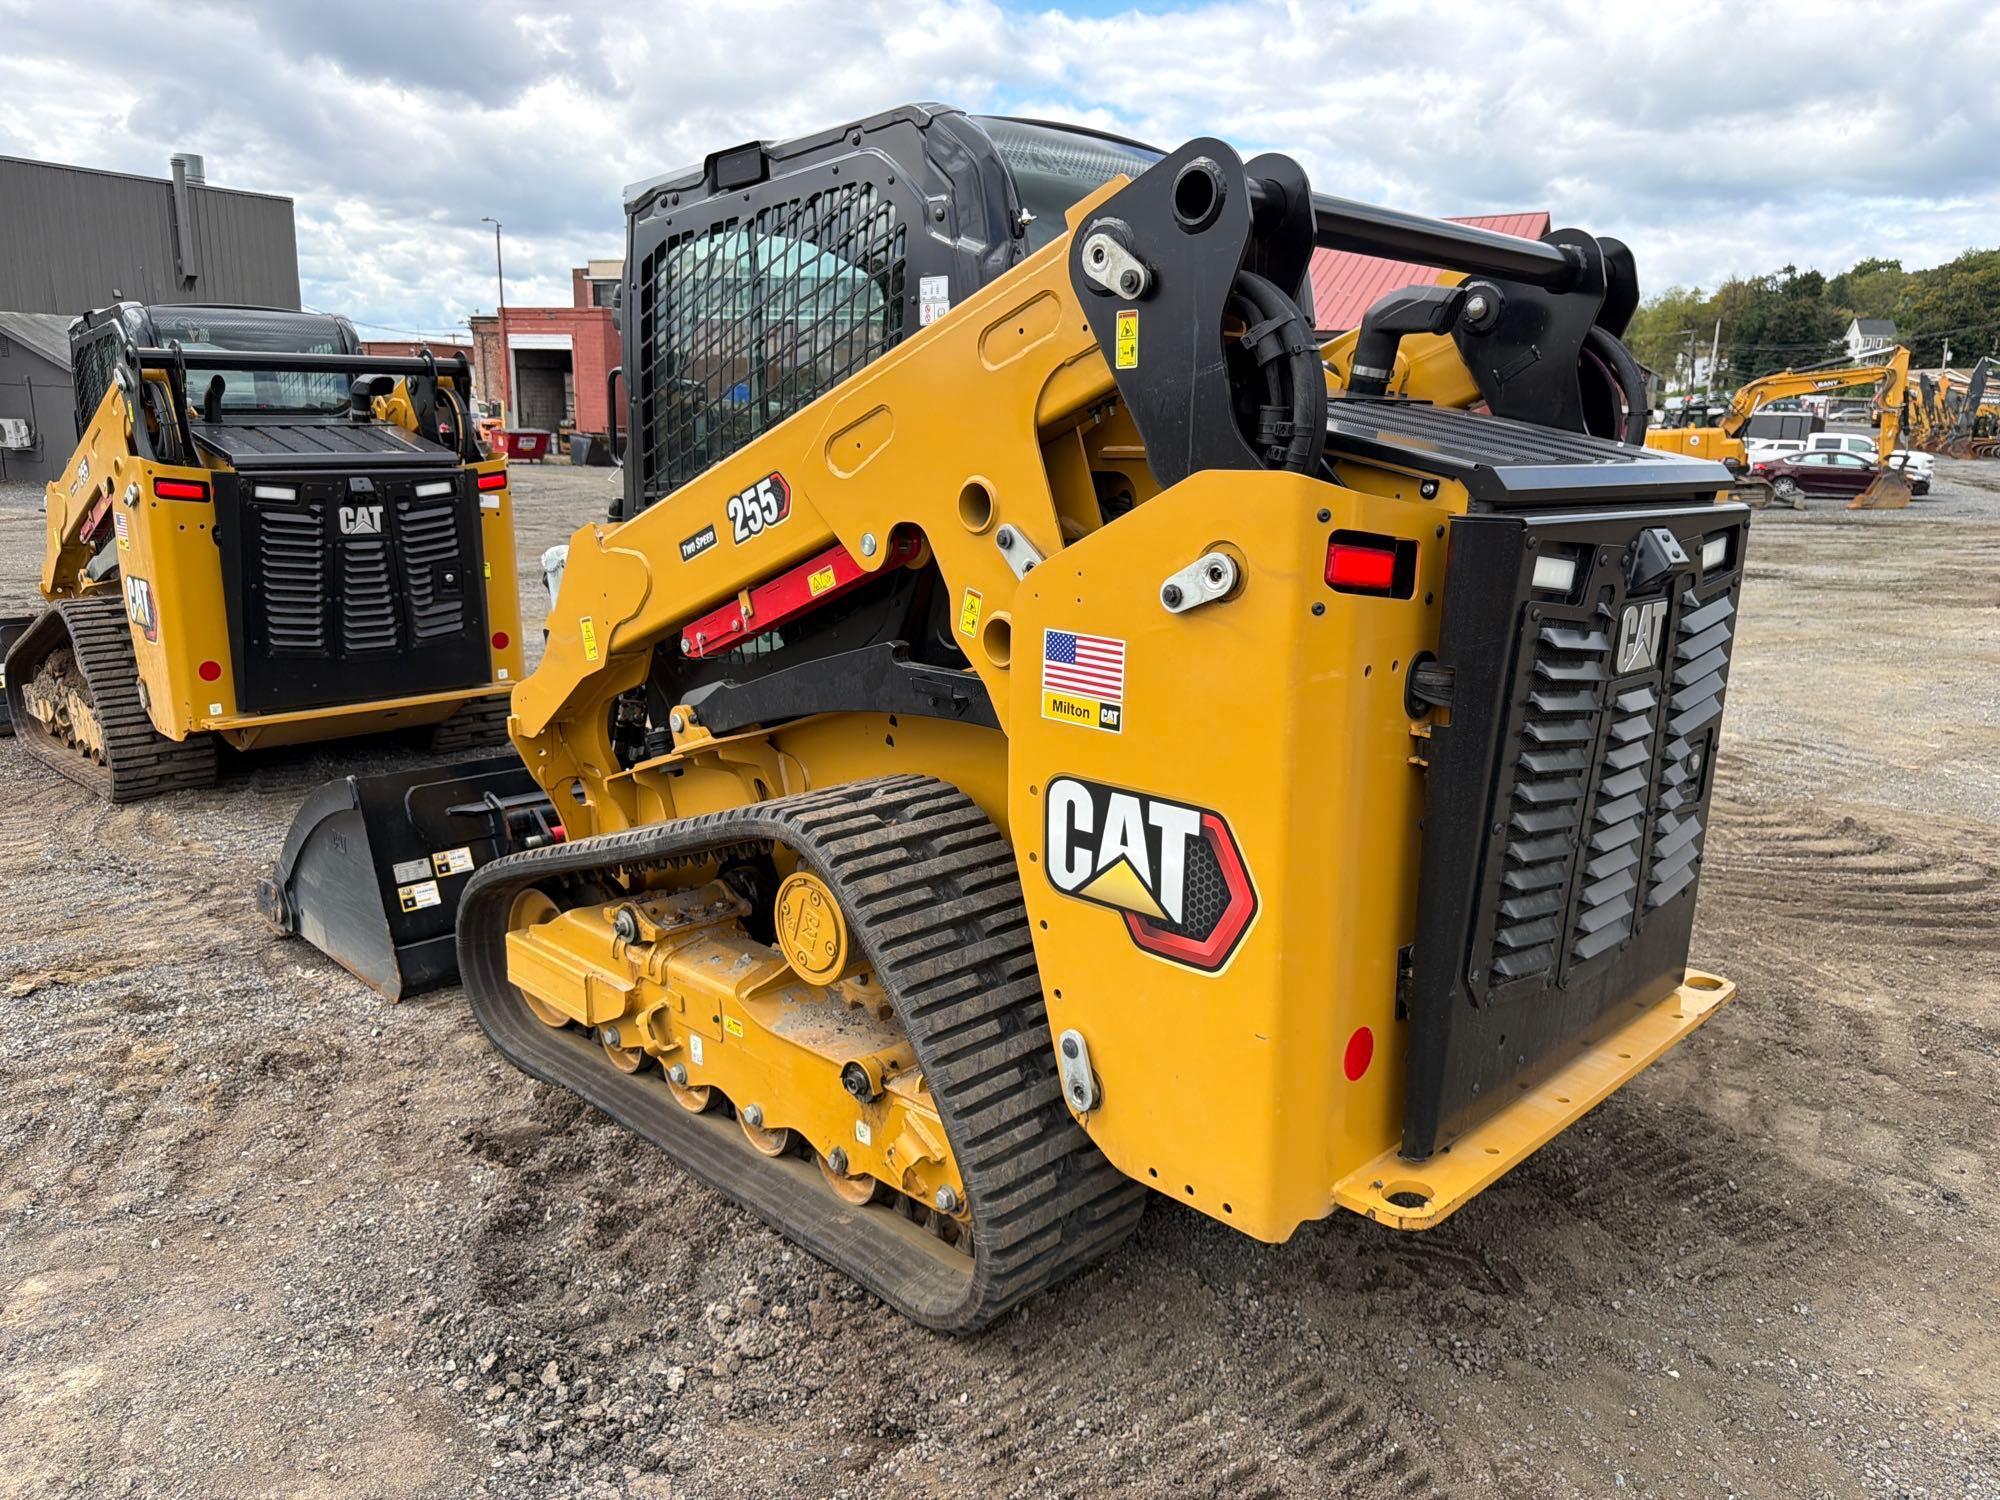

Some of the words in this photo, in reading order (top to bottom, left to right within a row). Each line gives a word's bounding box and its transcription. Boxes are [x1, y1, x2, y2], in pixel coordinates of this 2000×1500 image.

[339, 506, 384, 534] CAT
[727, 477, 779, 542] 255
[126, 576, 151, 627] CAT
[1617, 601, 1668, 674] CAT
[1052, 699, 1090, 719] Milton
[1101, 708, 1120, 725] CAT
[1048, 778, 1201, 925] CAT
